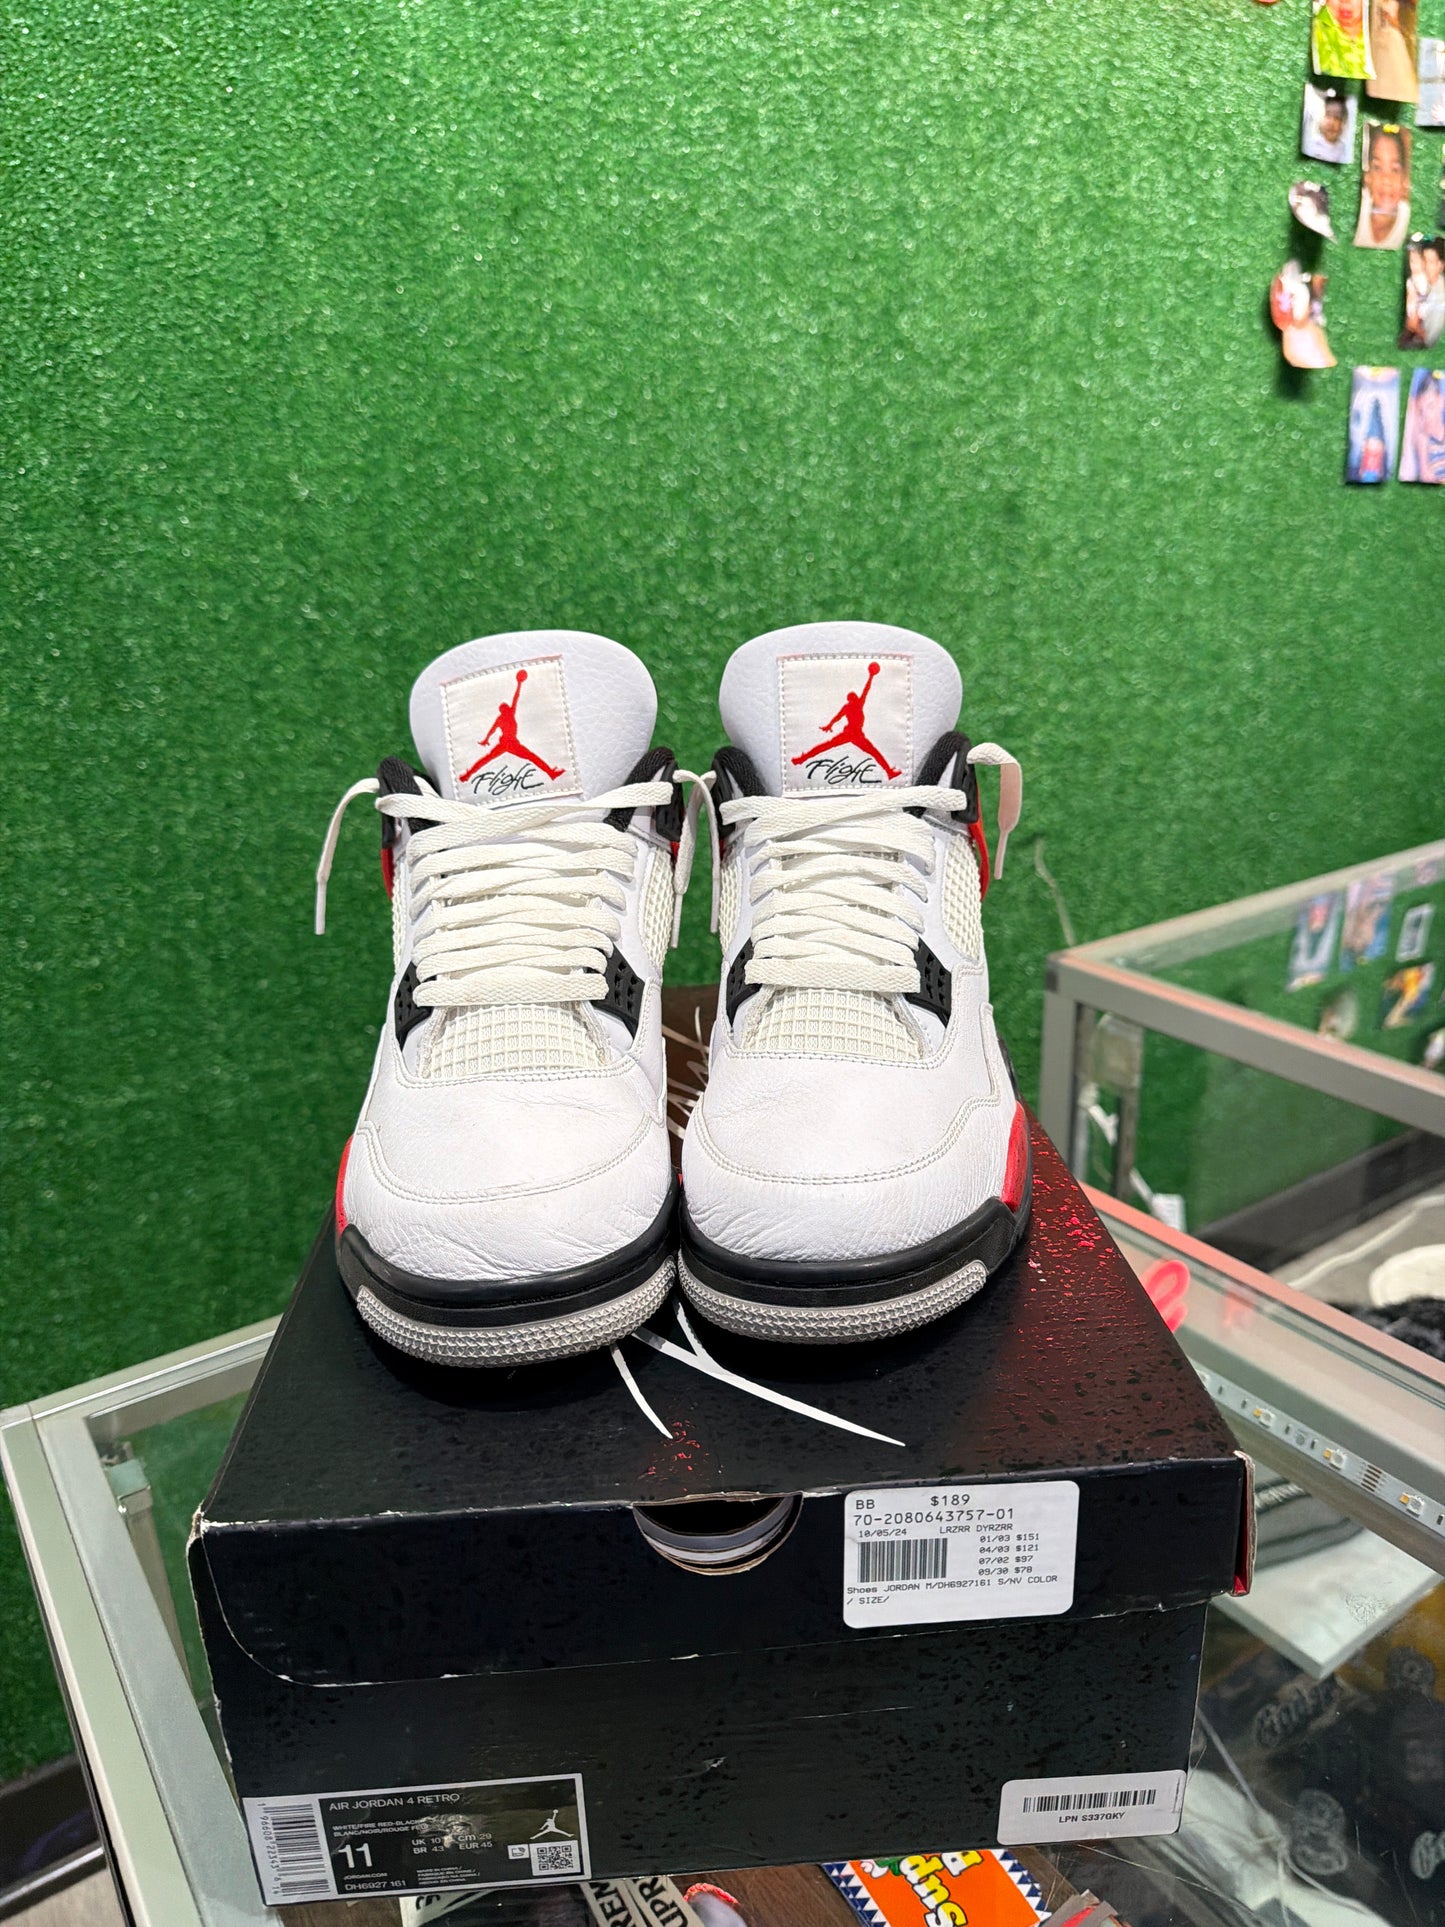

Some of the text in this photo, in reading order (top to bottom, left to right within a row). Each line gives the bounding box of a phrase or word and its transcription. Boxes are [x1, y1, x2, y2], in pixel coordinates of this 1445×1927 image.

[806, 756, 882, 784] Flight
[471, 763, 544, 796] Flight
[856, 1494, 970, 1510] BB $189
[853, 1508, 1014, 1526] 70-2080643757-01
[858, 1524, 1013, 1538] 10/05/24 LRZRR DYRZRR
[980, 1533, 1040, 1543] 01/03 $151
[979, 1544, 1039, 1554] 04/03 $121
[978, 1555, 1034, 1564] 07/02 $97
[978, 1566, 1032, 1576] 09/30 $78
[846, 1575, 1058, 1594] Shoes JORDAN M/DH6927161 S/NV COLOR
[858, 1596, 890, 1604] SIZE/
[329, 1802, 350, 1810] AIR
[352, 1798, 404, 1809] JORDAN
[417, 1794, 460, 1804] RETRO
[1058, 1814, 1078, 1824] LPN
[338, 1842, 373, 1868] 11
